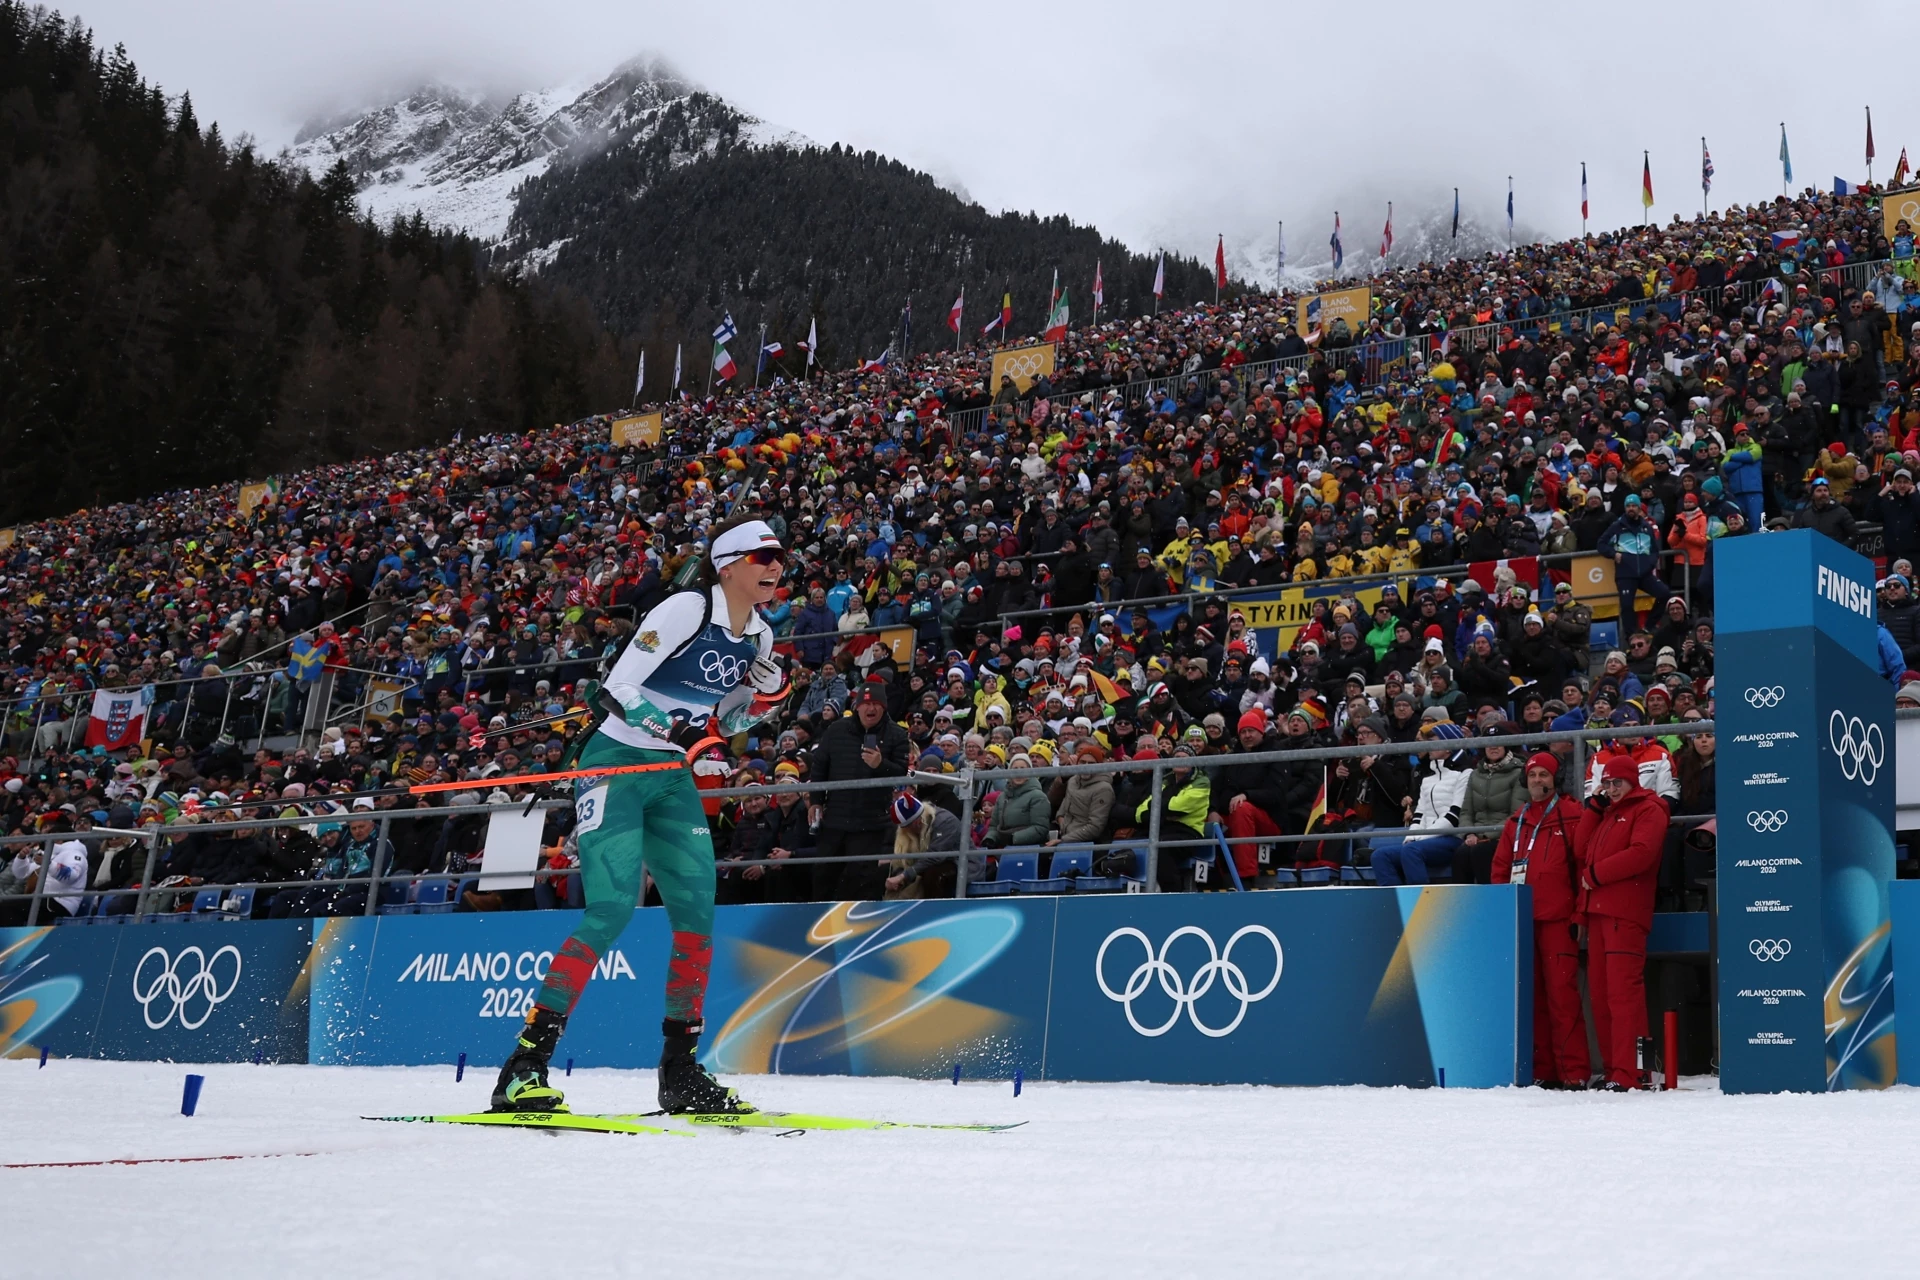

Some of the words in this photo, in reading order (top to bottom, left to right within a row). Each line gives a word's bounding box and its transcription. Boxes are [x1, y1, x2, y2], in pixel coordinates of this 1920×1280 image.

[1588, 567, 1604, 583] G
[1818, 564, 1872, 619] FINISH
[892, 639, 901, 653] F
[1733, 734, 1765, 742] MILANO
[1766, 731, 1799, 740] CORTINA
[1758, 740, 1774, 748] 2026
[577, 798, 595, 824] 23
[1261, 846, 1267, 860] 3
[1735, 859, 1767, 867] MILANO
[1768, 857, 1802, 866] CORTINA
[1198, 864, 1205, 880] 2
[1760, 866, 1777, 874] 2026
[397, 951, 511, 982] MILANO
[515, 950, 636, 981] CONA
[1736, 989, 1770, 997] MILANO
[1771, 989, 1806, 997] CORTINA
[479, 988, 535, 1018] 2026
[1763, 997, 1780, 1005] 2026
[512, 1114, 553, 1122] FISCHER
[694, 1115, 740, 1123] FISCHER
